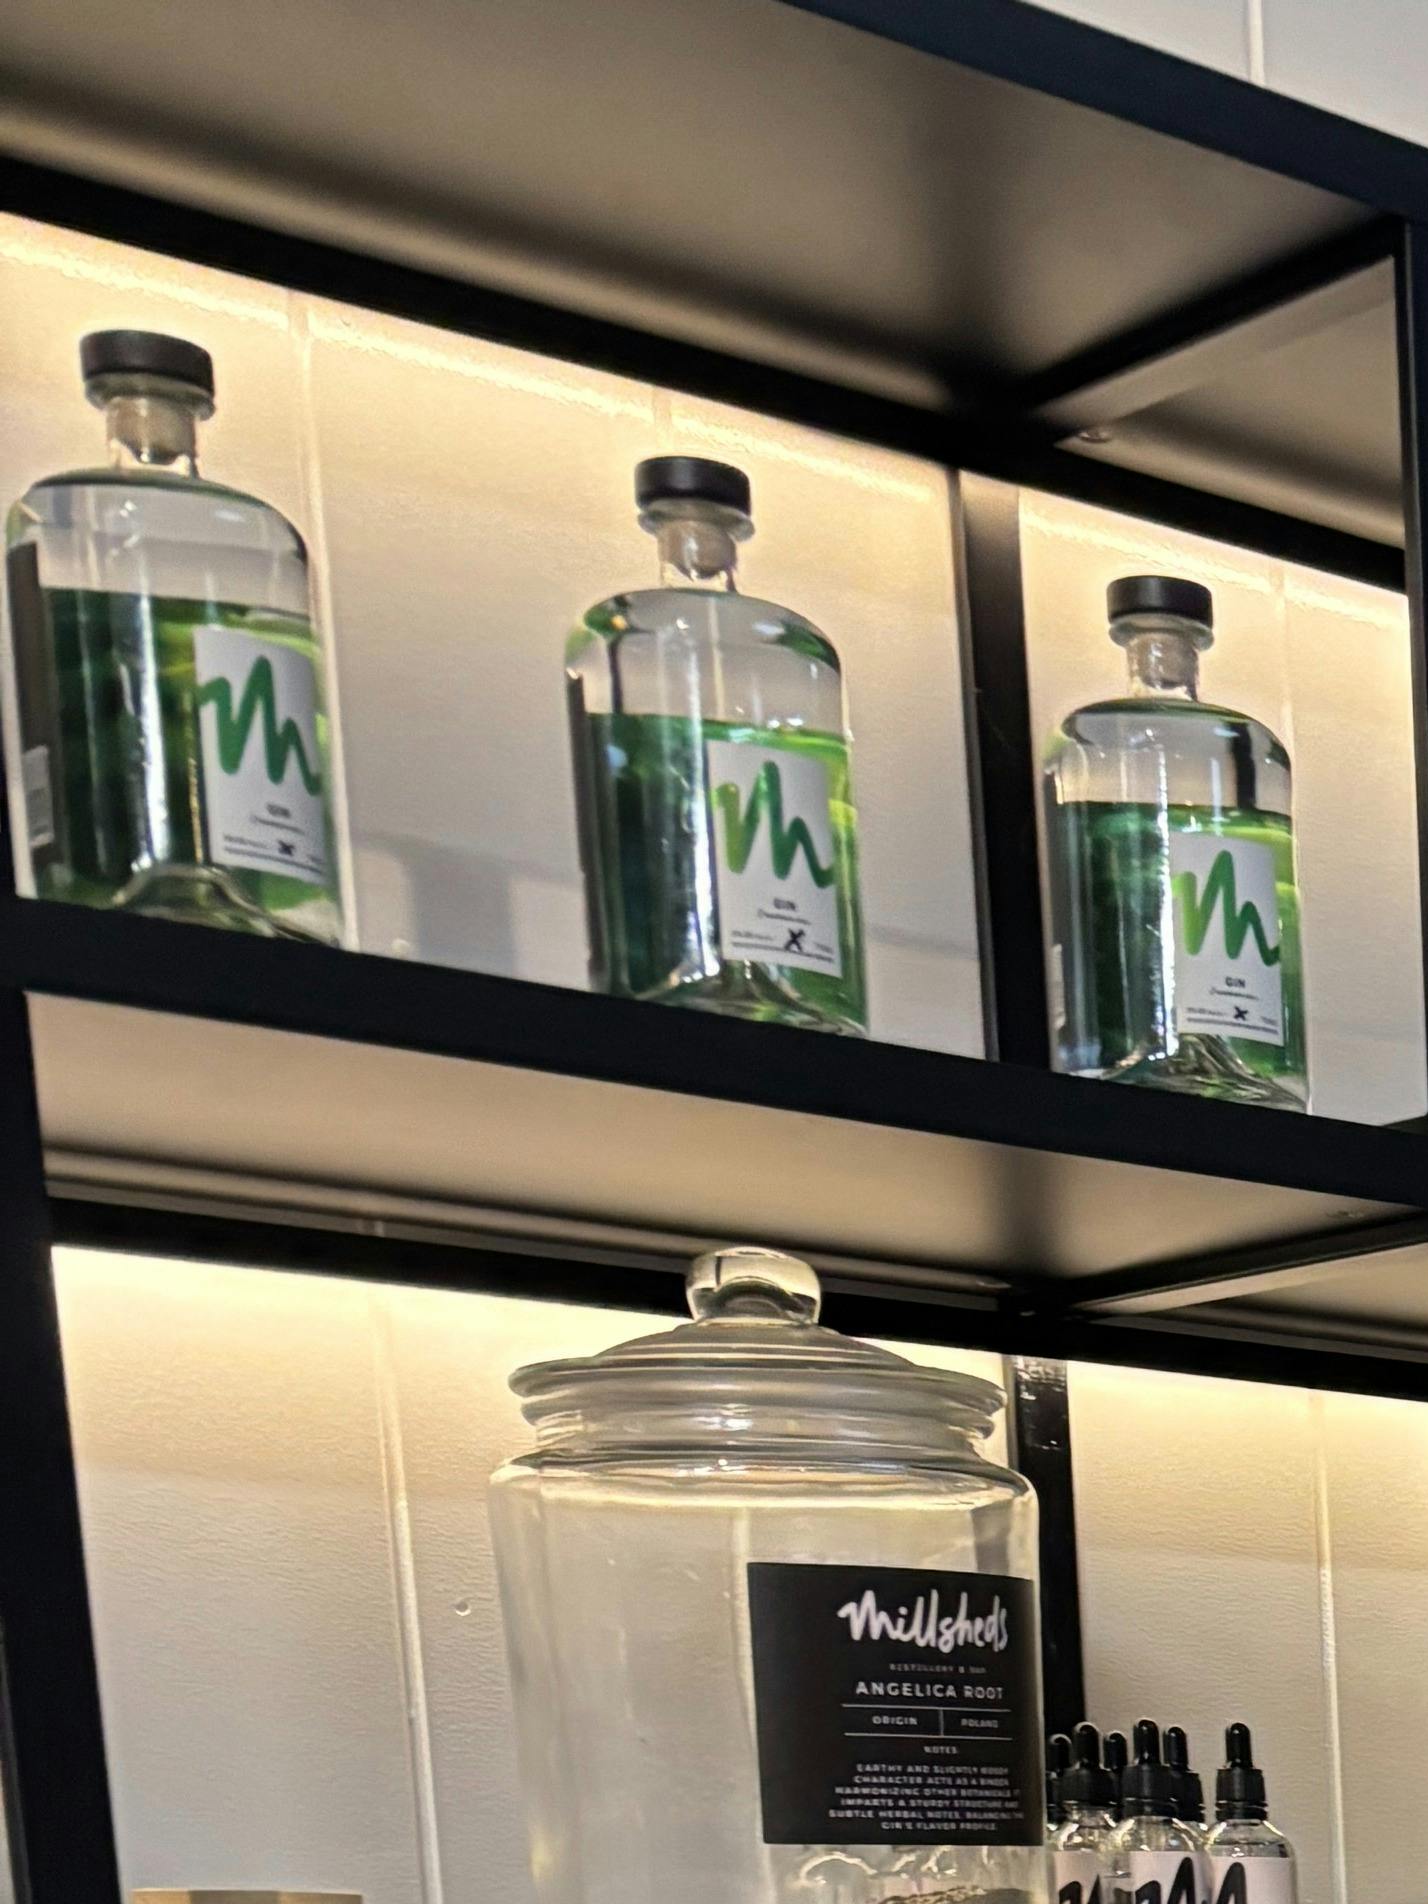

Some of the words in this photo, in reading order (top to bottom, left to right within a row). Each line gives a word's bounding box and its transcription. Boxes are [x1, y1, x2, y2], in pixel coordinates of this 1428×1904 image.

[855, 1681, 957, 1698] ANGELICA
[964, 1685, 1003, 1699] ROOT
[872, 1716, 917, 1725] ORIGIN
